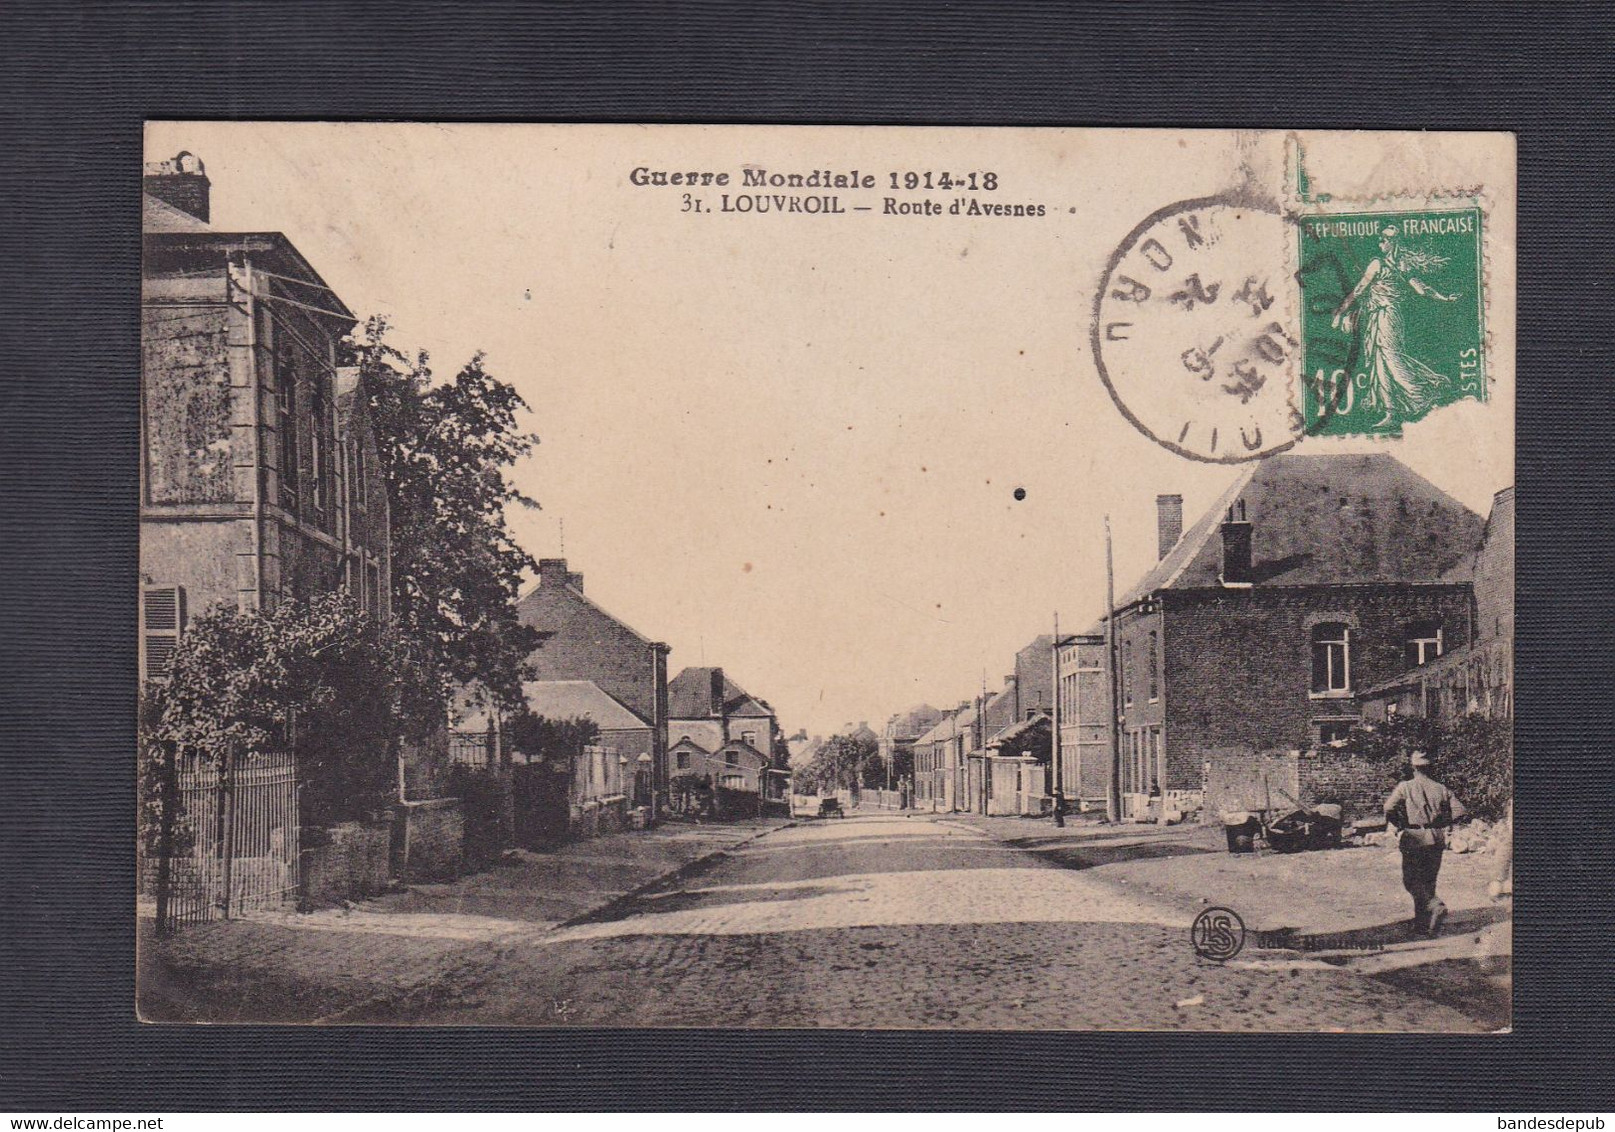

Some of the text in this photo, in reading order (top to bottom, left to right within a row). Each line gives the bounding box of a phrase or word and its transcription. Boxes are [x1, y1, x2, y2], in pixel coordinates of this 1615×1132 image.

[629, 167, 999, 190] Guerre Mondiale 1914-18
[681, 193, 711, 212] 31.
[721, 194, 845, 213] LOUVROIL
[883, 197, 942, 215] Route
[949, 197, 1046, 216] d'Avesnes
[1311, 369, 1354, 417] 10
